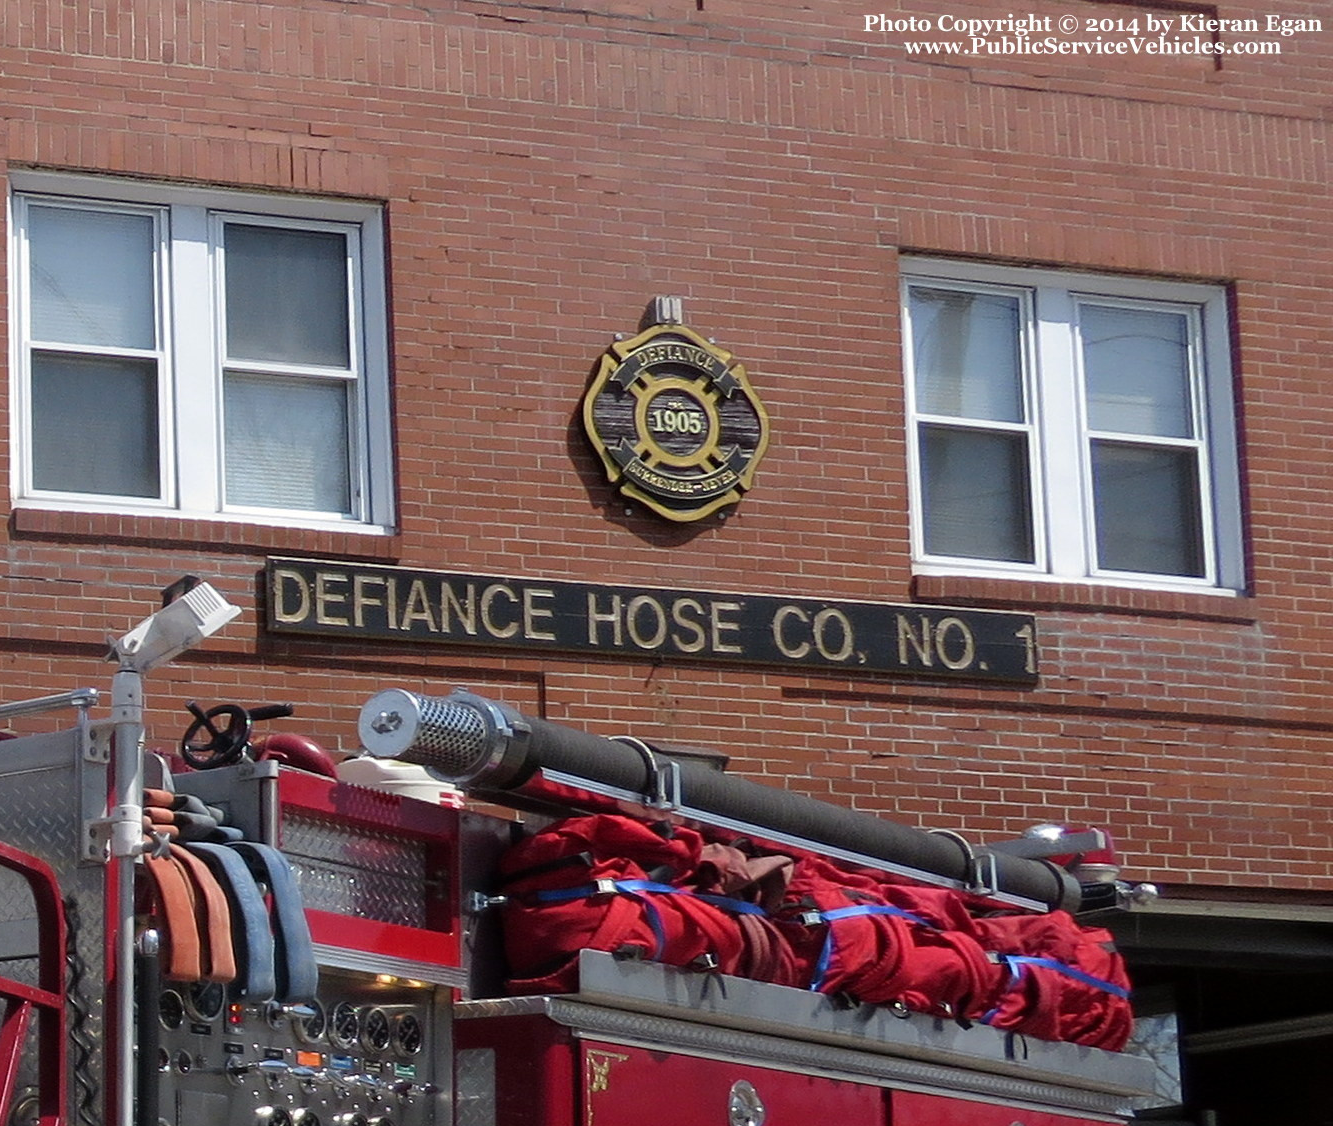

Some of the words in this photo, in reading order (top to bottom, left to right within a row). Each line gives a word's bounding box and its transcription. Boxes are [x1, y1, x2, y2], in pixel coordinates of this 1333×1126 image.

[636, 344, 715, 371] DEFIANCE
[652, 409, 702, 434] 1905
[272, 568, 558, 641] DEFIANCE
[586, 592, 744, 654] HOSE
[896, 612, 989, 671] NO.
[1014, 623, 1036, 675] 1
